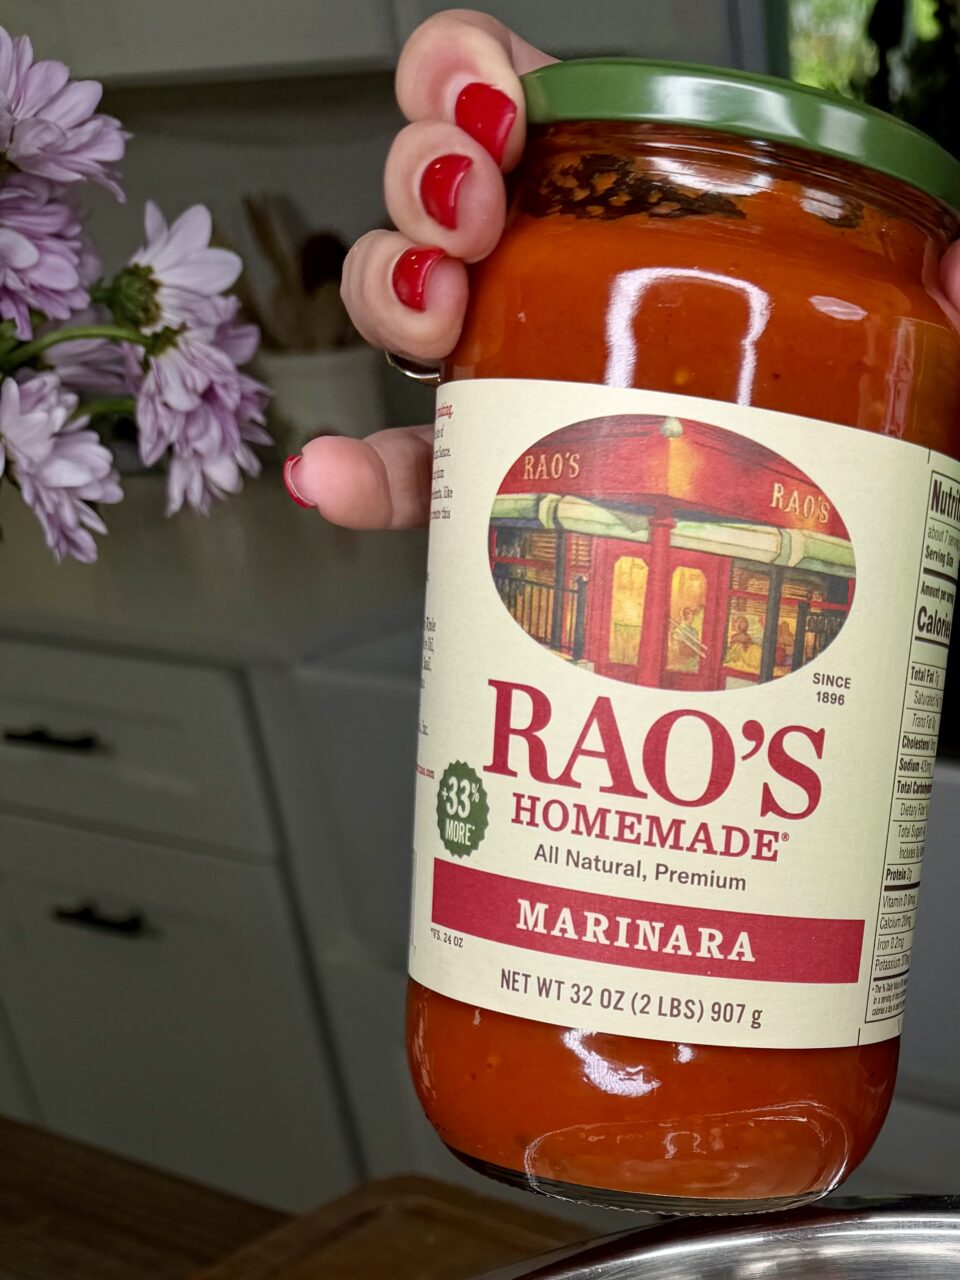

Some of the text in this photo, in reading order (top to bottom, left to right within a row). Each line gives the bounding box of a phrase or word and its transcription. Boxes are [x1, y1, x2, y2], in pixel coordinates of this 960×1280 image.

[523, 452, 581, 481] RAO'S
[770, 482, 831, 524] RAO'S
[925, 545, 946, 568] Serving
[812, 672, 853, 690] SINCE
[911, 666, 926, 682] Total
[926, 669, 935, 684] Fat
[815, 690, 846, 707] 1896
[482, 678, 826, 821] RAO'S
[899, 757, 920, 773] Sodium
[897, 780, 912, 794] Total
[441, 776, 480, 819] +33%
[534, 843, 747, 892] All Natural, Premium
[886, 868, 906, 882] Protein
[516, 898, 756, 962] MARINARA
[880, 916, 901, 930] Calcium
[443, 933, 452, 945] 24
[453, 936, 464, 948] OZ
[500, 967, 763, 1030] NET WT 32 OZ (2 LBS) 907 g
